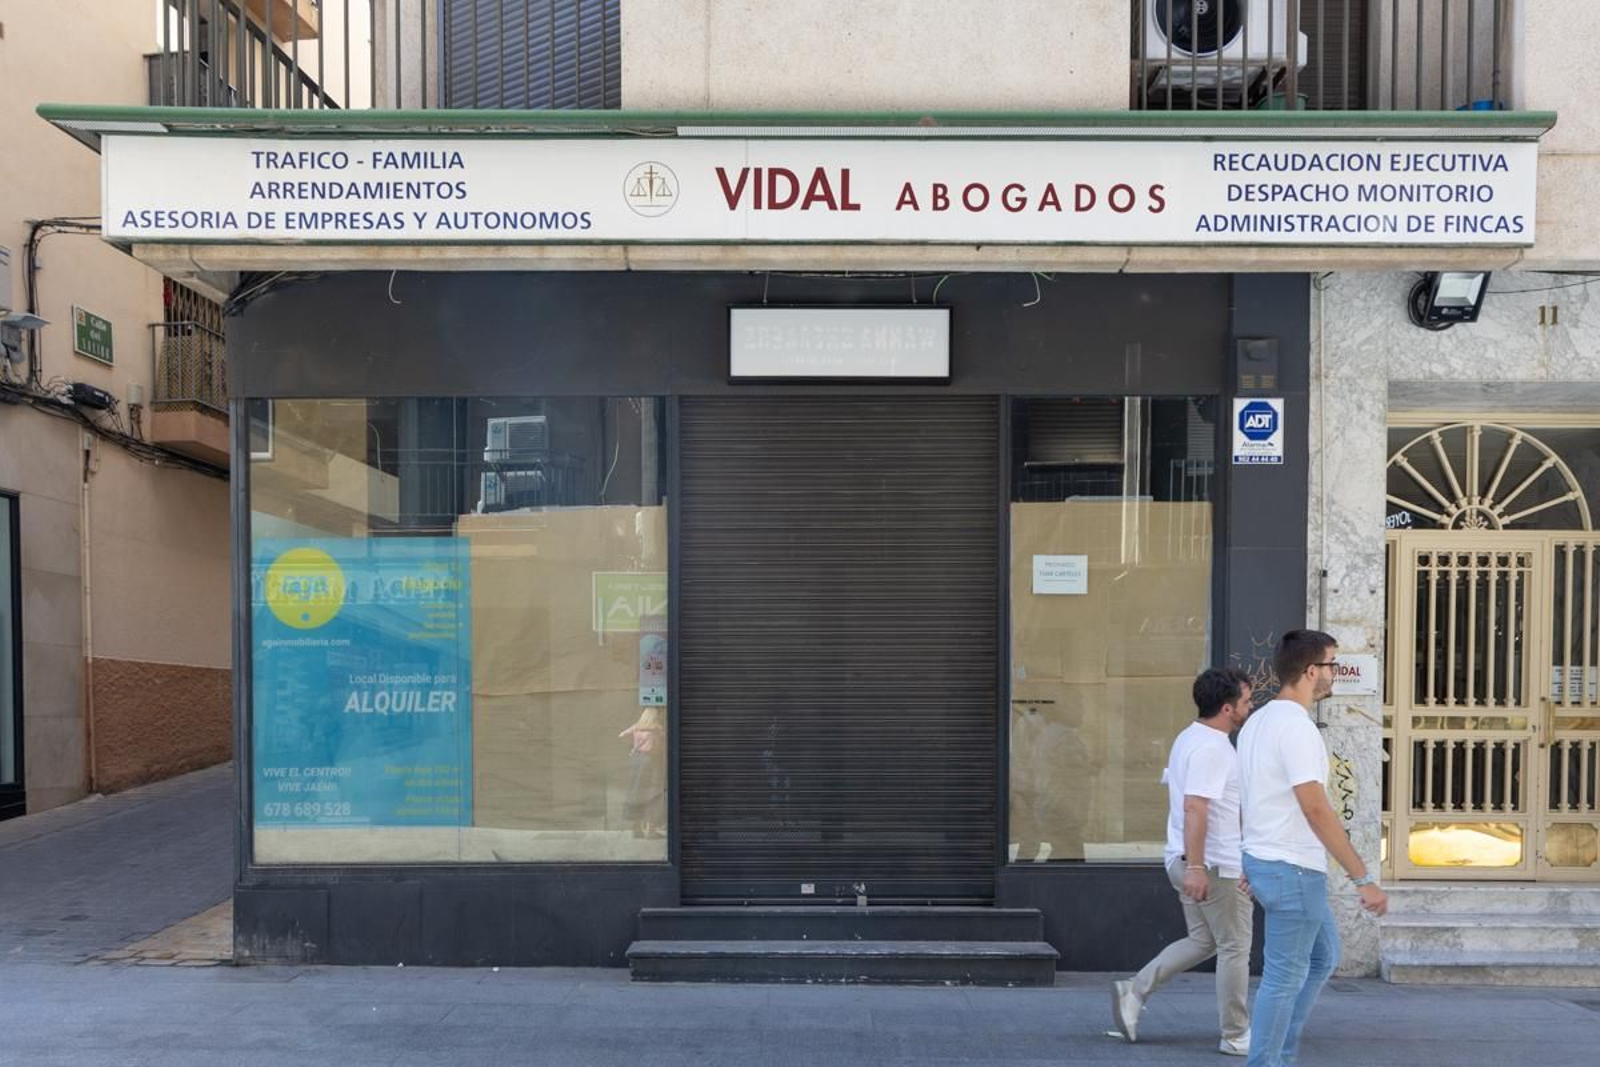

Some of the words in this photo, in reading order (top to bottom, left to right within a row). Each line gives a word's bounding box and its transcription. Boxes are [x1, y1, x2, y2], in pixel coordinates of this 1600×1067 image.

[250, 151, 350, 170] TRAFICO
[372, 151, 465, 170] FAMILIA
[1213, 153, 1382, 172] RECAUDACION
[1389, 153, 1509, 173] EJECUTIVA
[249, 180, 468, 200] ARRENDAMIENTOS
[714, 166, 862, 212] VIDAL
[894, 181, 1166, 214] ABOGADOS
[1227, 183, 1350, 203] DESPACHO
[1357, 183, 1494, 204] MONITORIO
[121, 209, 239, 230] ASESORIA
[247, 211, 277, 230] DE
[284, 211, 406, 231] EMPRESAS
[412, 211, 428, 230] Y
[435, 211, 592, 231] AUTONOMOS
[1194, 213, 1398, 233] ADMINISTRACION
[1406, 214, 1436, 233] DE
[1443, 214, 1525, 234] FINCAS
[1539, 304, 1558, 326] 11
[1246, 415, 1272, 428] ADT
[348, 673, 377, 684] Local
[378, 672, 432, 685] Disponible
[434, 674, 457, 686] para
[344, 691, 457, 715] ALQUILER
[263, 768, 288, 777] VIVE
[289, 768, 301, 777] EL
[278, 781, 301, 792] VIVE
[263, 801, 291, 817] 678
[294, 801, 321, 817] 689
[324, 801, 351, 816] 528
